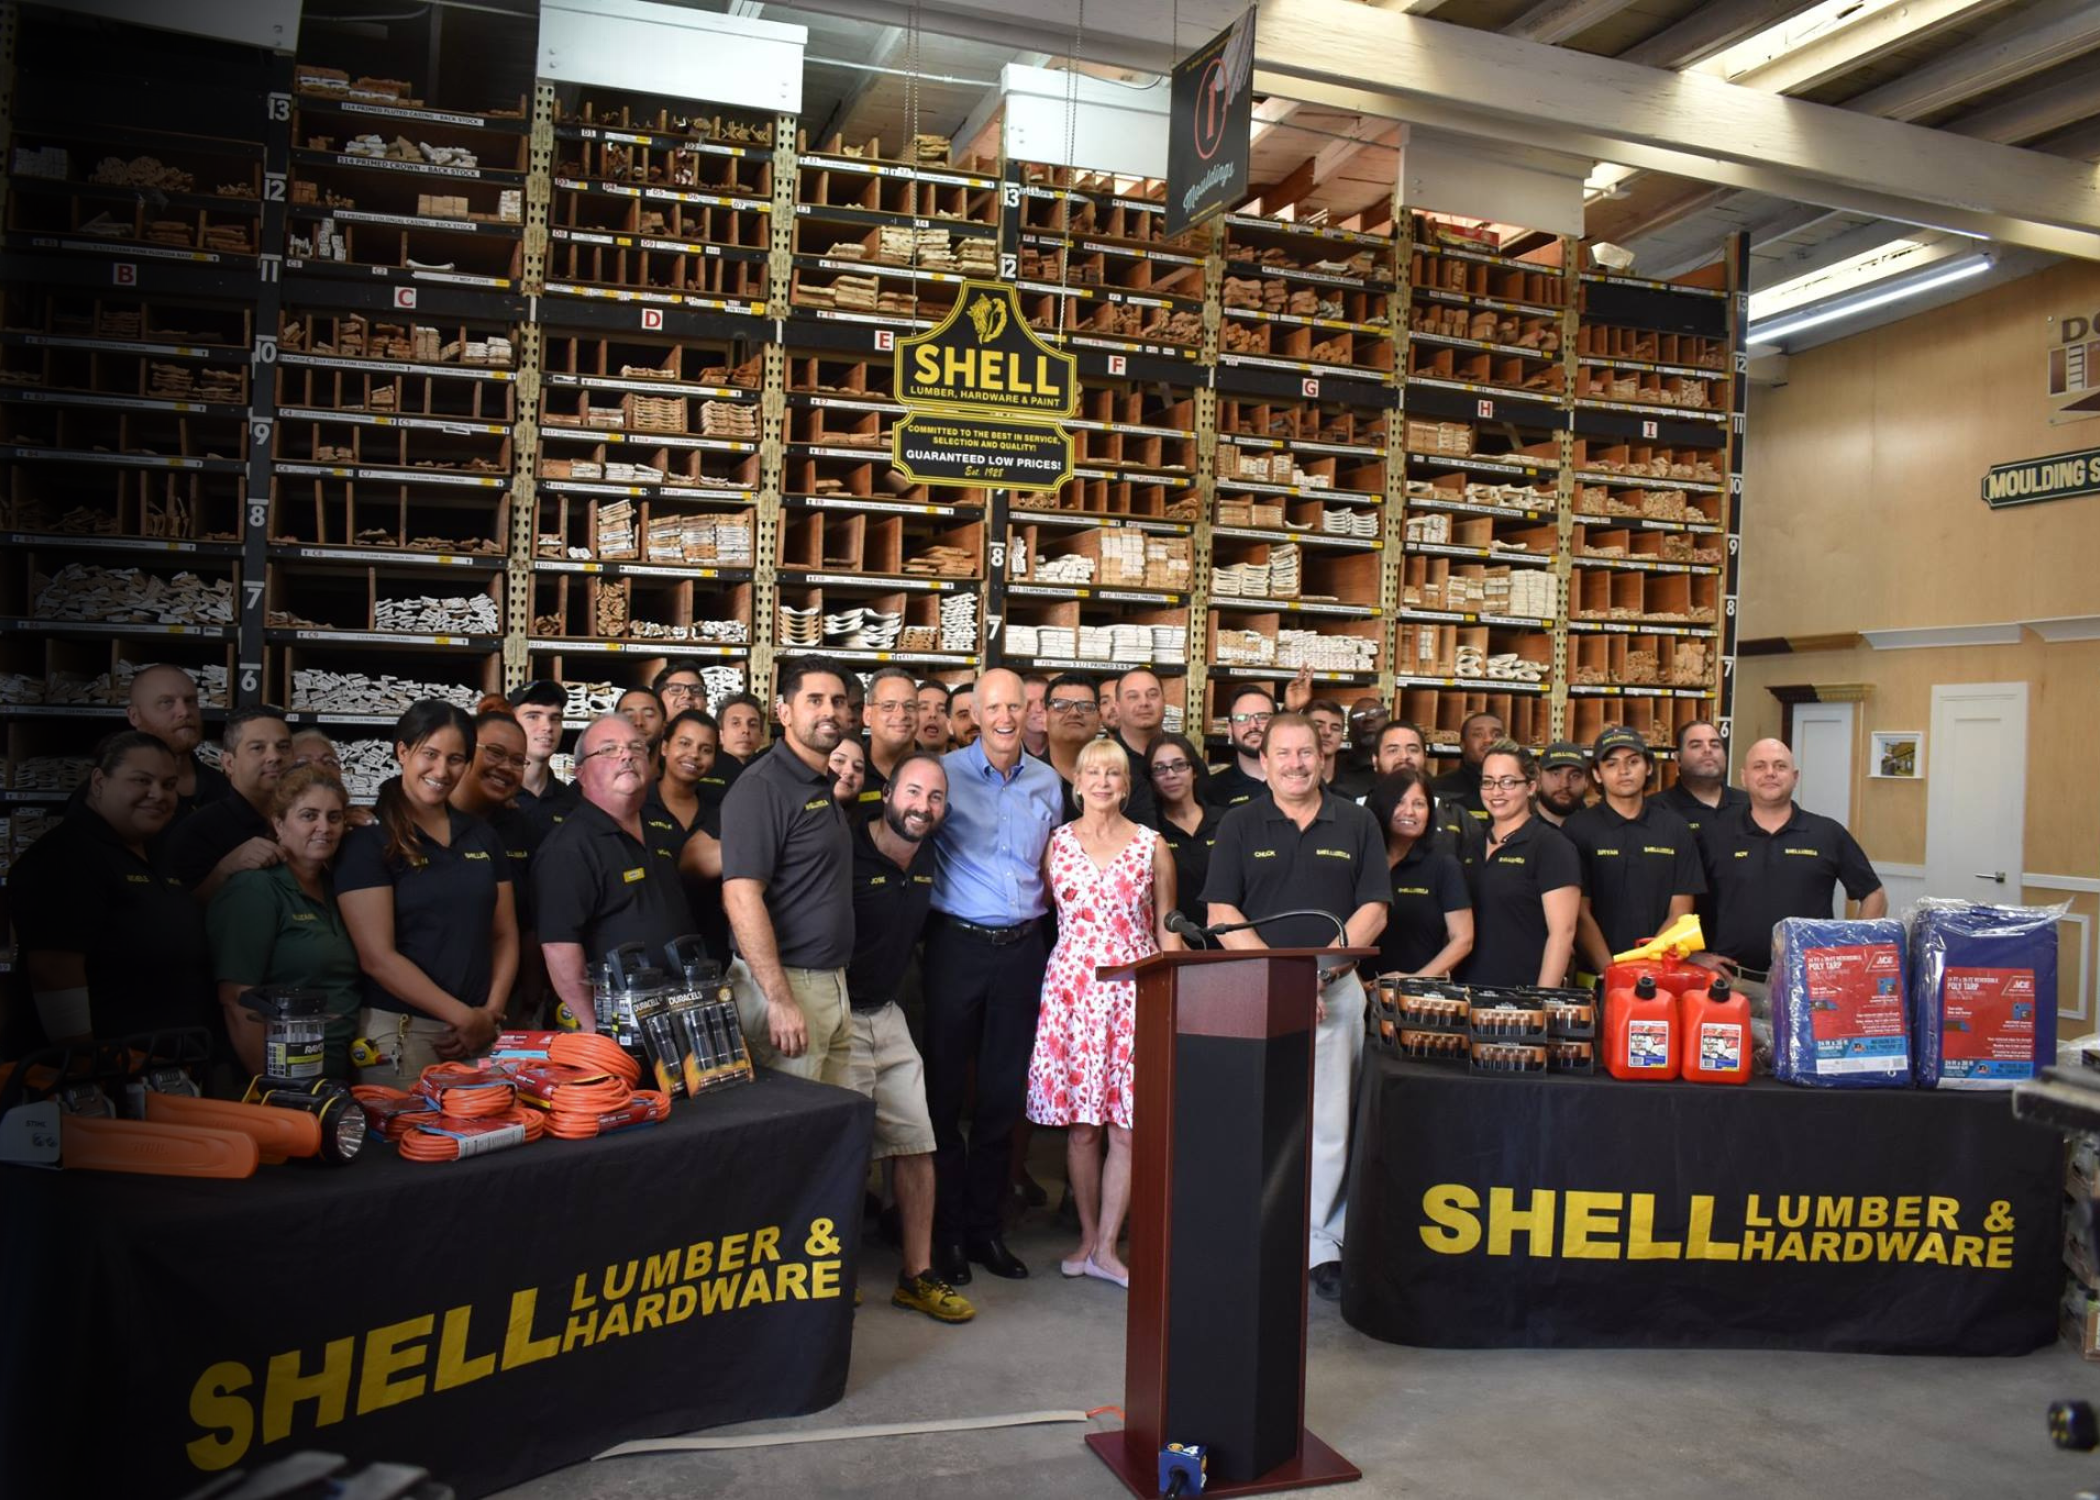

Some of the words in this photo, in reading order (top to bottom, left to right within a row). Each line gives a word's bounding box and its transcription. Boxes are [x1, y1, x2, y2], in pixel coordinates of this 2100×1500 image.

[268, 99, 290, 121] 13
[357, 158, 388, 168] PRIMED
[389, 162, 421, 172] CROWN
[428, 166, 449, 174] BACK
[450, 168, 476, 177] STOCK
[264, 180, 285, 202] 12
[1182, 161, 1235, 214] Mouldings
[1004, 189, 1019, 207] 13
[118, 266, 134, 283] B
[261, 260, 278, 282] 11
[1001, 259, 1017, 278] 12
[397, 289, 415, 307] C
[1736, 296, 1748, 312] 13
[645, 311, 661, 327] D
[879, 332, 891, 349] E
[256, 341, 277, 364] 10
[914, 343, 1060, 395] SHELL
[1113, 357, 1123, 372] F
[1735, 356, 1747, 373] 12
[910, 385, 958, 399] LUMBER,
[960, 390, 1020, 405] HARDWARE
[1021, 395, 1028, 404] &
[1031, 396, 1061, 407] PAINT
[1304, 381, 1317, 396] G
[1480, 402, 1492, 417] H
[907, 424, 958, 436] COMMITTED
[960, 428, 972, 437] TO
[974, 429, 990, 439] THE
[992, 430, 1012, 441] BEST
[1014, 432, 1022, 441] IN
[1024, 433, 1061, 445] SERVICE,
[1648, 423, 1654, 437] I
[1734, 417, 1743, 434] 11
[253, 424, 270, 446] 9
[933, 436, 979, 448] SELECTION
[981, 439, 998, 449] AND
[906, 449, 986, 464] GUARANTEED
[988, 455, 1014, 467] LOW
[1016, 458, 1062, 471] PRICES!
[1730, 479, 1742, 494] 10
[1988, 459, 2087, 499] MOULDING
[249, 505, 266, 528] 8
[1729, 540, 1738, 555] 9
[991, 548, 1004, 567] 8
[246, 588, 264, 610] 7
[1726, 601, 1735, 617] 8
[988, 622, 1001, 640] 7
[1724, 661, 1733, 677] 7
[240, 668, 257, 692] 6
[1720, 724, 1729, 738] 6
[2012, 980, 2031, 989] ACE
[634, 997, 662, 1012] DURACELL
[668, 990, 703, 1006] DURACELL
[25, 1119, 47, 1129] STIHL
[1418, 1183, 1741, 1262] SHELL
[1745, 1194, 1960, 1232] LUMBER
[1981, 1199, 2016, 1234] &
[1741, 1230, 2016, 1270] HARDWARE
[570, 1225, 782, 1313] LUMBER
[802, 1217, 842, 1258] &
[561, 1259, 843, 1354] HARDWARE
[185, 1286, 562, 1472] SHELL
